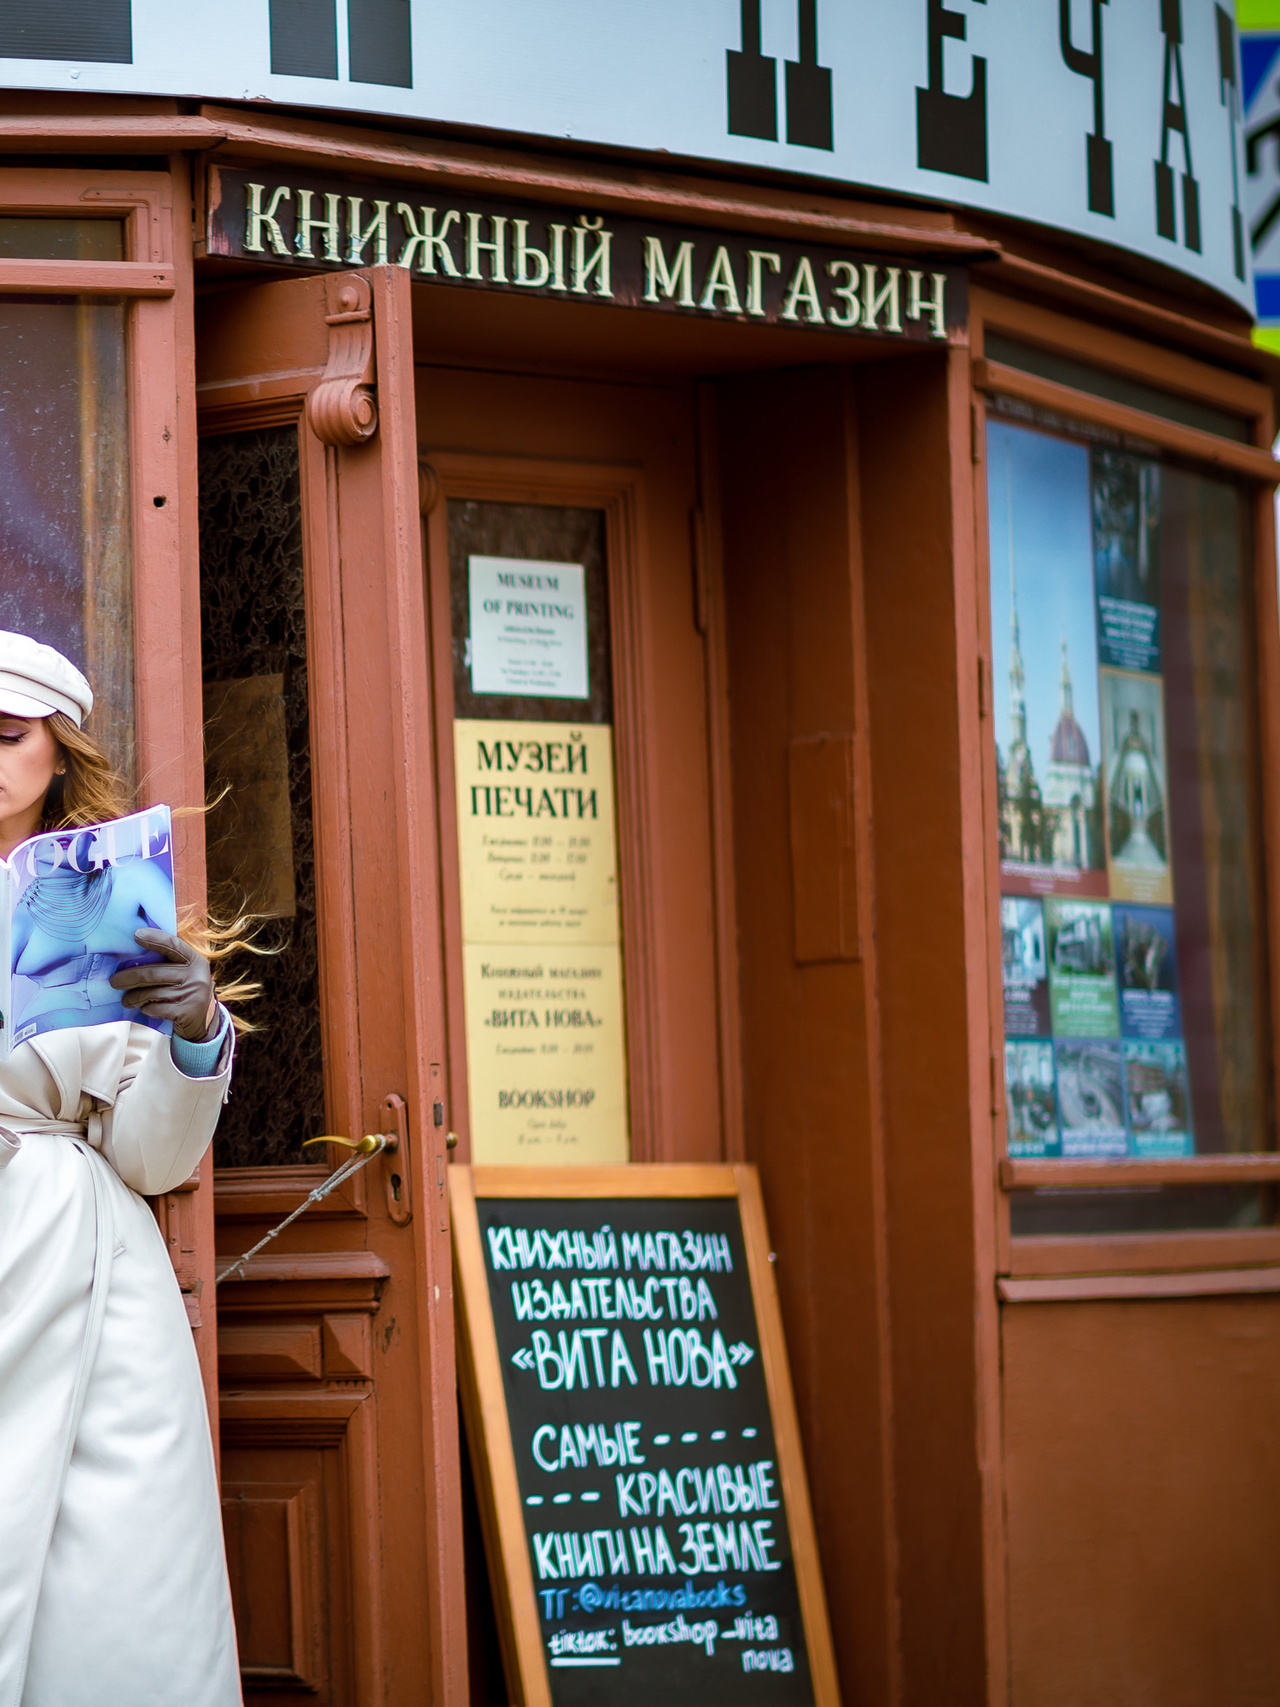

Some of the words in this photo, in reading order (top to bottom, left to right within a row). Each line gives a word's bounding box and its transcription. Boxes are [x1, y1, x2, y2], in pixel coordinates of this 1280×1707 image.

[243, 182, 614, 298] КНИЖНЫЙ
[641, 235, 948, 339] МАГАЗИН
[496, 571, 560, 592] MUSEUM
[483, 598, 502, 615] OF
[506, 599, 576, 620] PRINTING
[477, 730, 589, 775] МУЗЕЙ
[470, 785, 599, 820] ПЕЧАТИ
[11, 809, 171, 889] VOGUE
[498, 1089, 596, 1109] BOOKSHOP
[622, 1230, 734, 1273] МАГАЗИН
[512, 1276, 718, 1322] ИЗДАТЕЛЬСТВА
[511, 1328, 638, 1390] «ВИТА
[643, 1327, 755, 1390] НОВА»
[532, 1421, 646, 1472] САМЫЕ
[616, 1461, 780, 1518] КРАСИВЫЕ
[533, 1529, 630, 1580] КНИГИ
[629, 1524, 677, 1575] НА
[677, 1519, 782, 1576] ЗЕМЛЕ
[741, 1647, 796, 1673] nova
